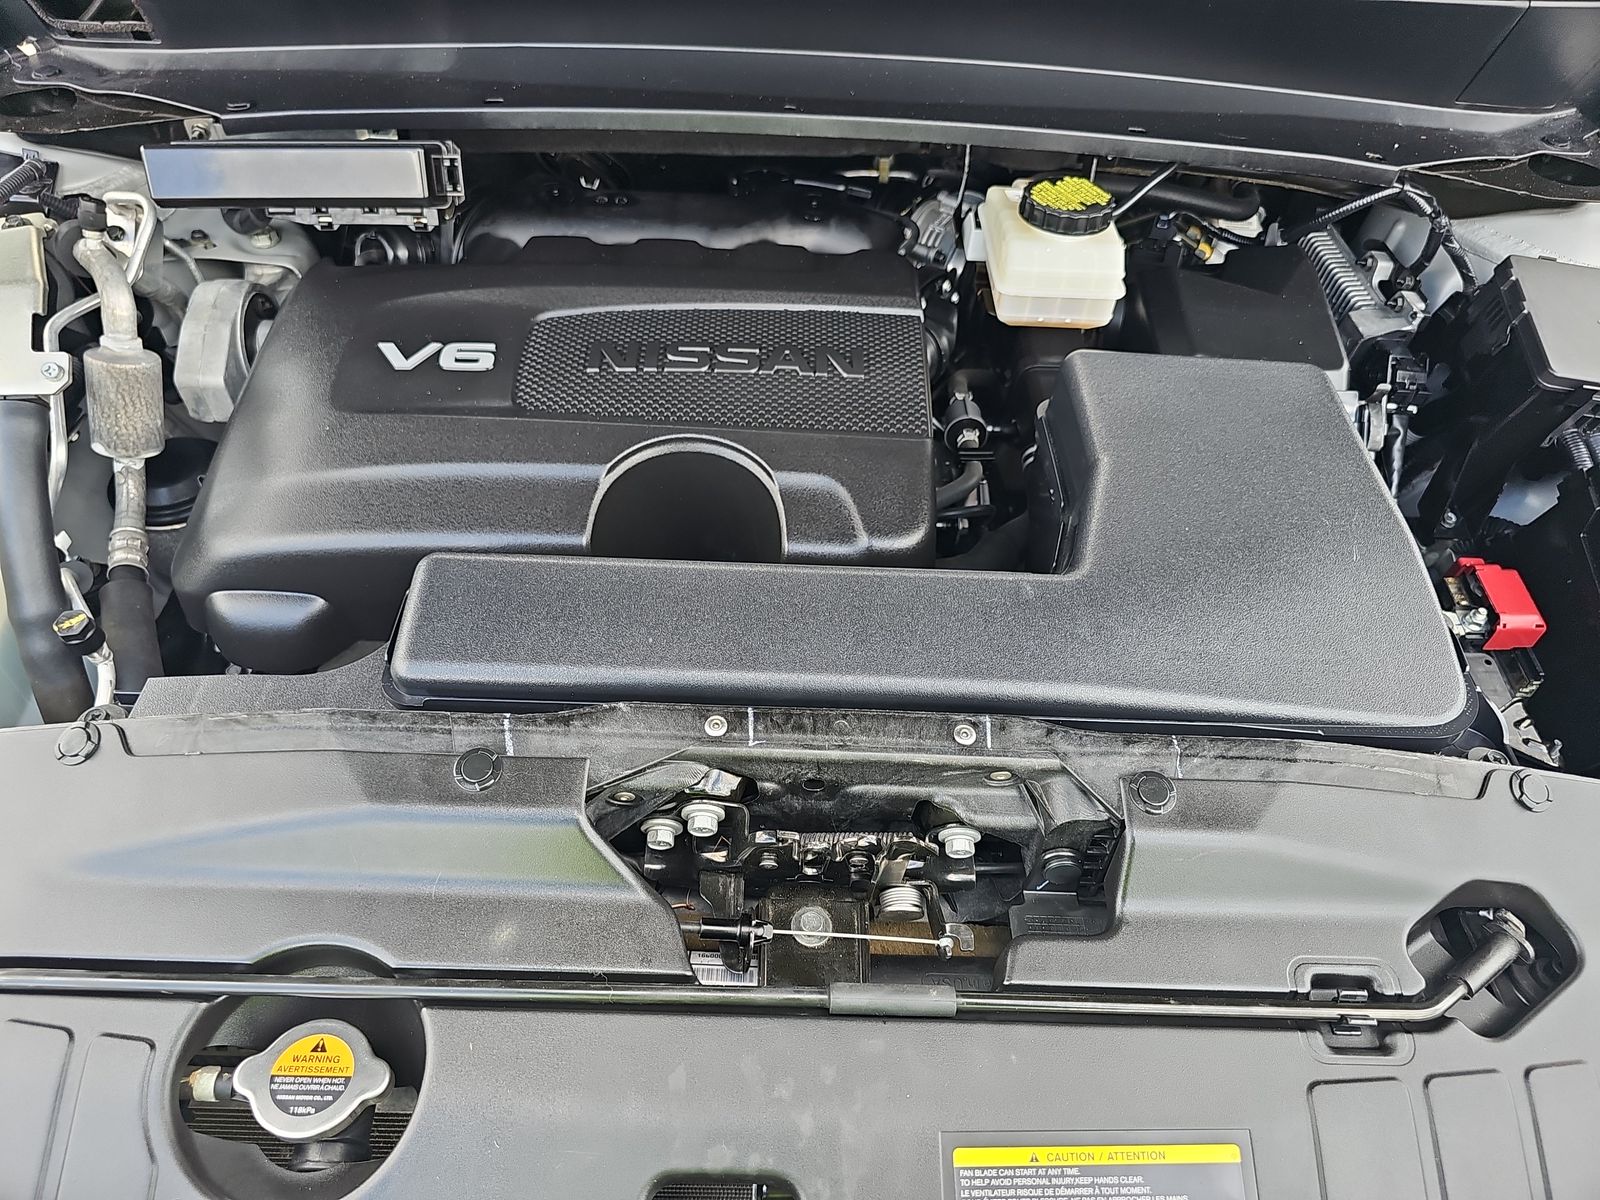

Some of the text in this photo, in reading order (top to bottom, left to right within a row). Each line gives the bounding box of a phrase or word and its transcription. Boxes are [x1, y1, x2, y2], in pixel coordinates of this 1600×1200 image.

[378, 341, 497, 372] V6
[586, 340, 865, 378] NISSAN
[292, 1054, 341, 1064] WARNING
[277, 1065, 350, 1074] AVERTISSEMENT
[1047, 1152, 1095, 1162] CAUTION
[1107, 1151, 1166, 1161] ATTENTION
[960, 1169, 974, 1177] FAN
[974, 1169, 998, 1177] BLADE
[999, 1168, 1014, 1176] CAN
[1015, 1168, 1037, 1176] START
[1047, 1167, 1062, 1175] ANY
[1063, 1167, 1080, 1175] TIME.
[960, 1179, 970, 1187] TO
[971, 1178, 990, 1186] HELP
[991, 1178, 1012, 1186] AVOID
[1013, 1177, 1051, 1186] PERSONAL
[1094, 1176, 1119, 1184] HANDS
[1120, 1176, 1145, 1184] CLEAR.
[960, 1185, 1153, 1197] LE VENTILATEUR RISQUE DE DÉMARRER À TOUT MOMENT.
